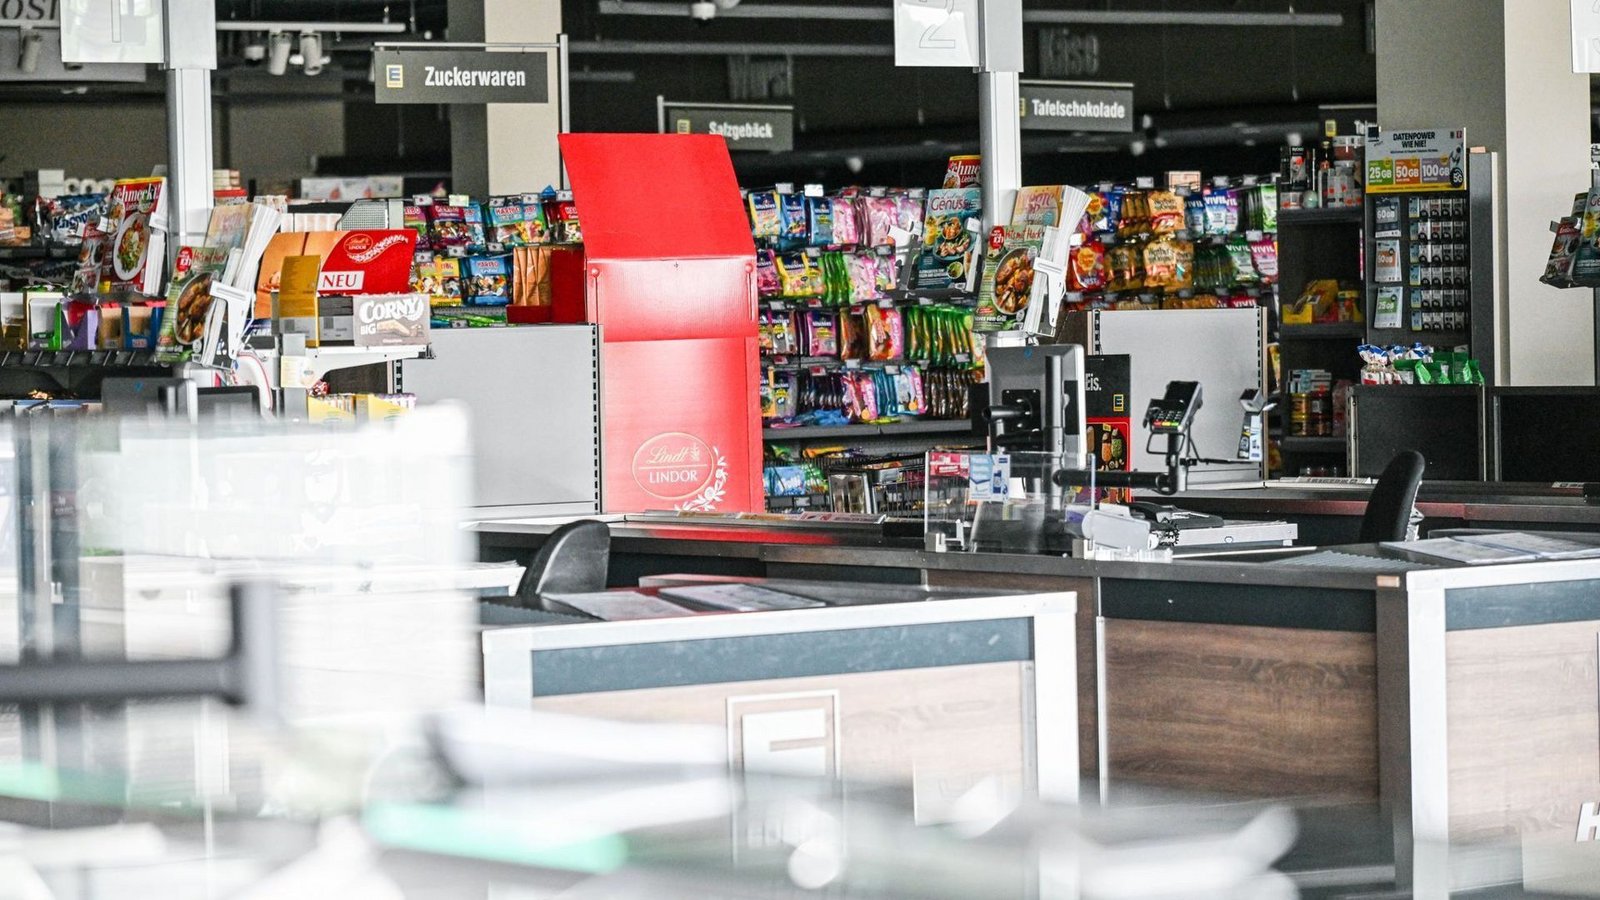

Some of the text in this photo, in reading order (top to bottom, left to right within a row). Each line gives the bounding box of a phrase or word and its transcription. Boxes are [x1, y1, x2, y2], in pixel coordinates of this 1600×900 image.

[424, 66, 526, 87] Zuckerwaren
[1032, 98, 1125, 119] Tafelschokolade
[708, 121, 774, 141] Salzgebäck
[1393, 132, 1435, 140] DATENPOWER
[1401, 140, 1427, 149] WIE NIE!
[1369, 166, 1393, 179] 25 GB
[1396, 165, 1419, 178] 50 GB
[1422, 164, 1450, 177] 100 GB
[322, 274, 357, 287] NEU
[359, 295, 424, 323] CORNY
[360, 323, 377, 336] BIG
[1085, 373, 1102, 391] Eis.
[650, 470, 698, 484] LINDOR
